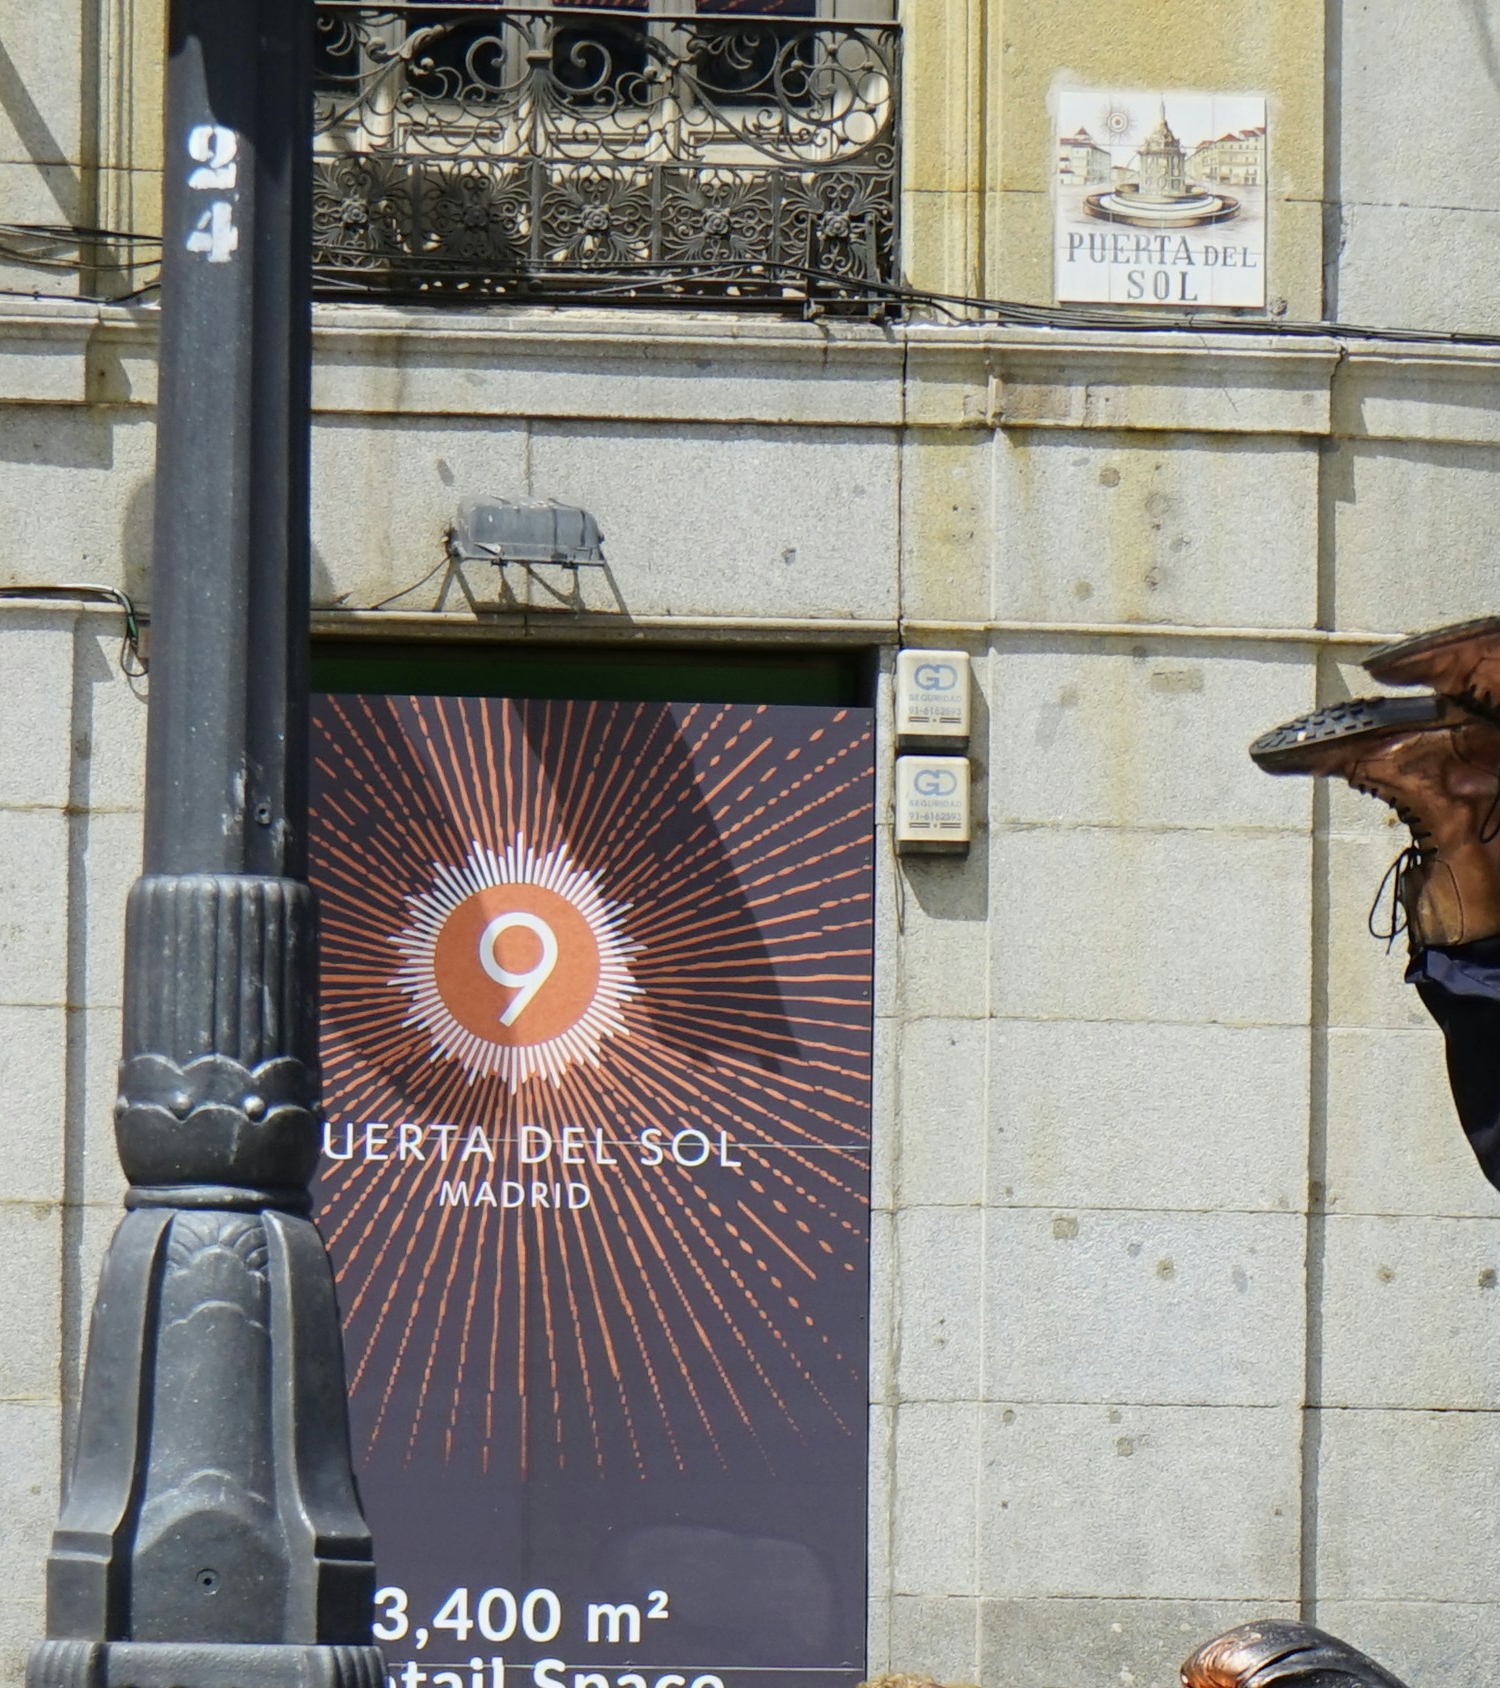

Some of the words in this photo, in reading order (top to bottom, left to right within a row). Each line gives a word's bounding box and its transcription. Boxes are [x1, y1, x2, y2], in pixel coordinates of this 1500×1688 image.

[1067, 232, 1196, 266] PUERTA
[1204, 245, 1257, 268] DEL
[1127, 270, 1198, 301] SOL
[479, 911, 559, 1028] 9
[322, 1122, 495, 1163] UERTA
[520, 1126, 617, 1165] DEL
[640, 1129, 743, 1167] SOL
[439, 1180, 591, 1209] MADRID
[372, 1587, 562, 1649] 3,400
